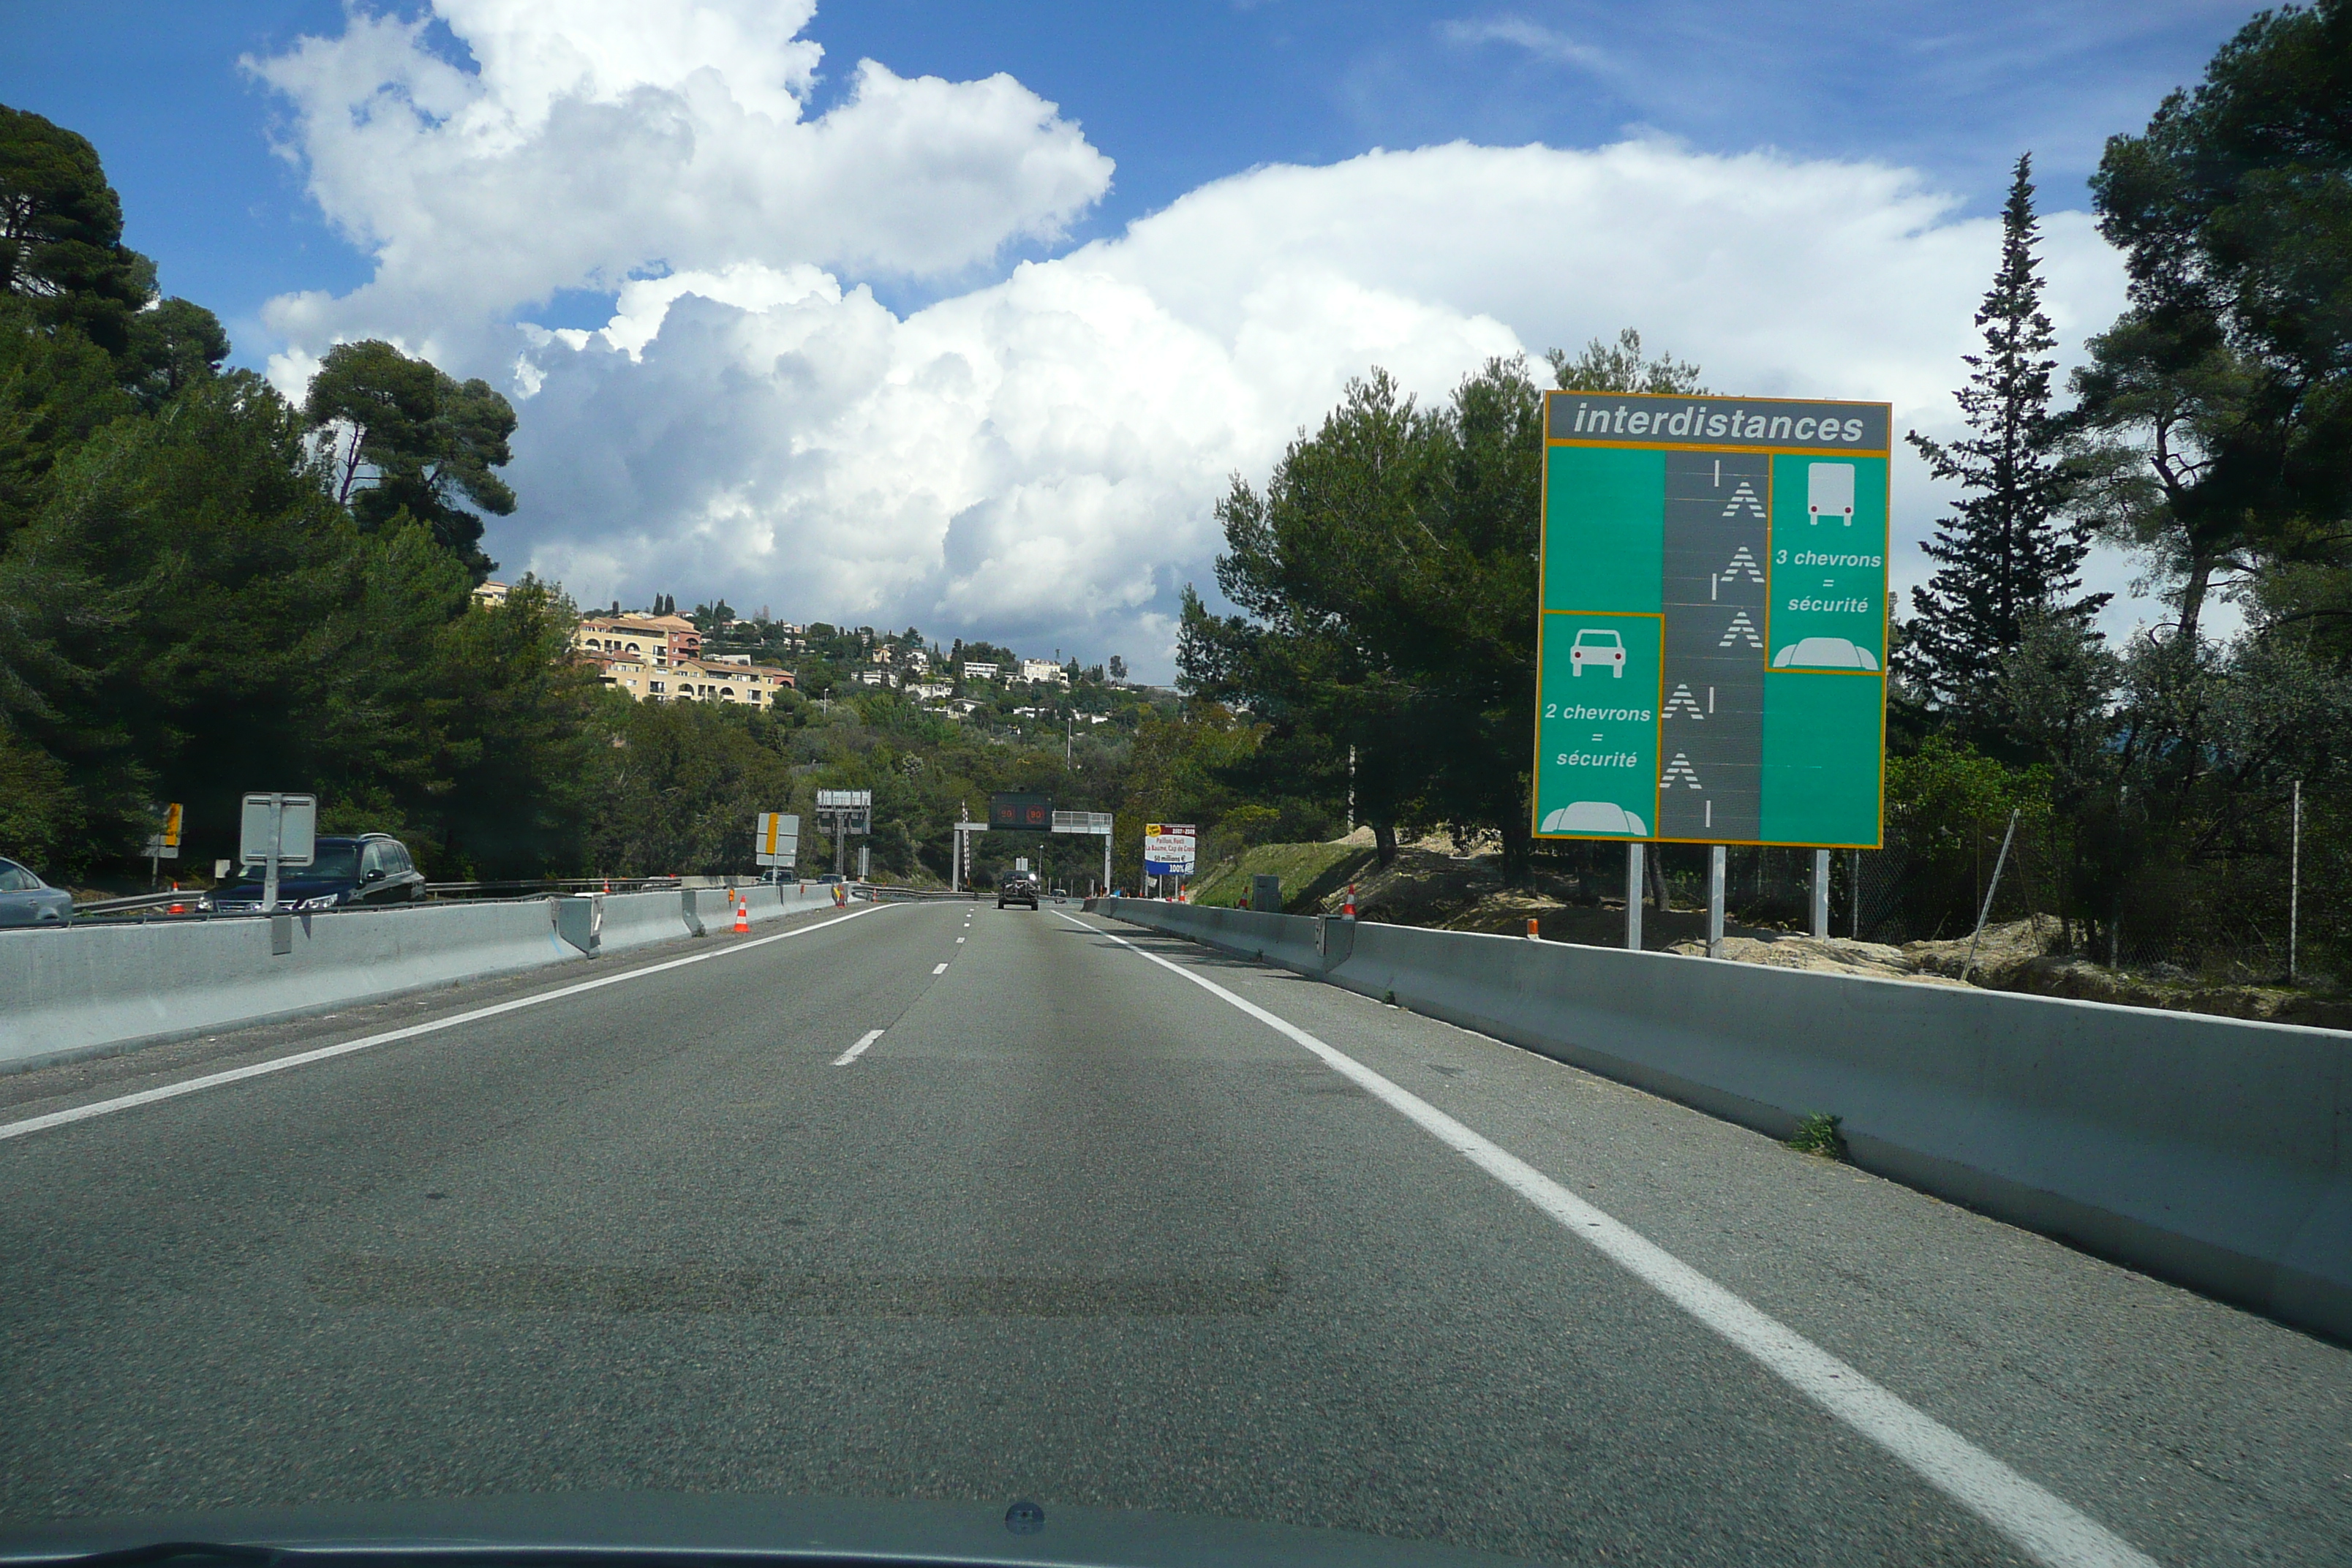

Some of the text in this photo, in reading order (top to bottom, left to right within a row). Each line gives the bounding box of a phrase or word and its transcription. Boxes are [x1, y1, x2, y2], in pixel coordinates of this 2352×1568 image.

[1574, 402, 1864, 442] interdistances
[1776, 549, 1882, 568] 3 chevrons
[1787, 595, 1869, 613] sécurité
[1545, 703, 1651, 722] 2 chevrons
[1556, 750, 1637, 768] sécurité
[1169, 864, 1185, 873] 100%
